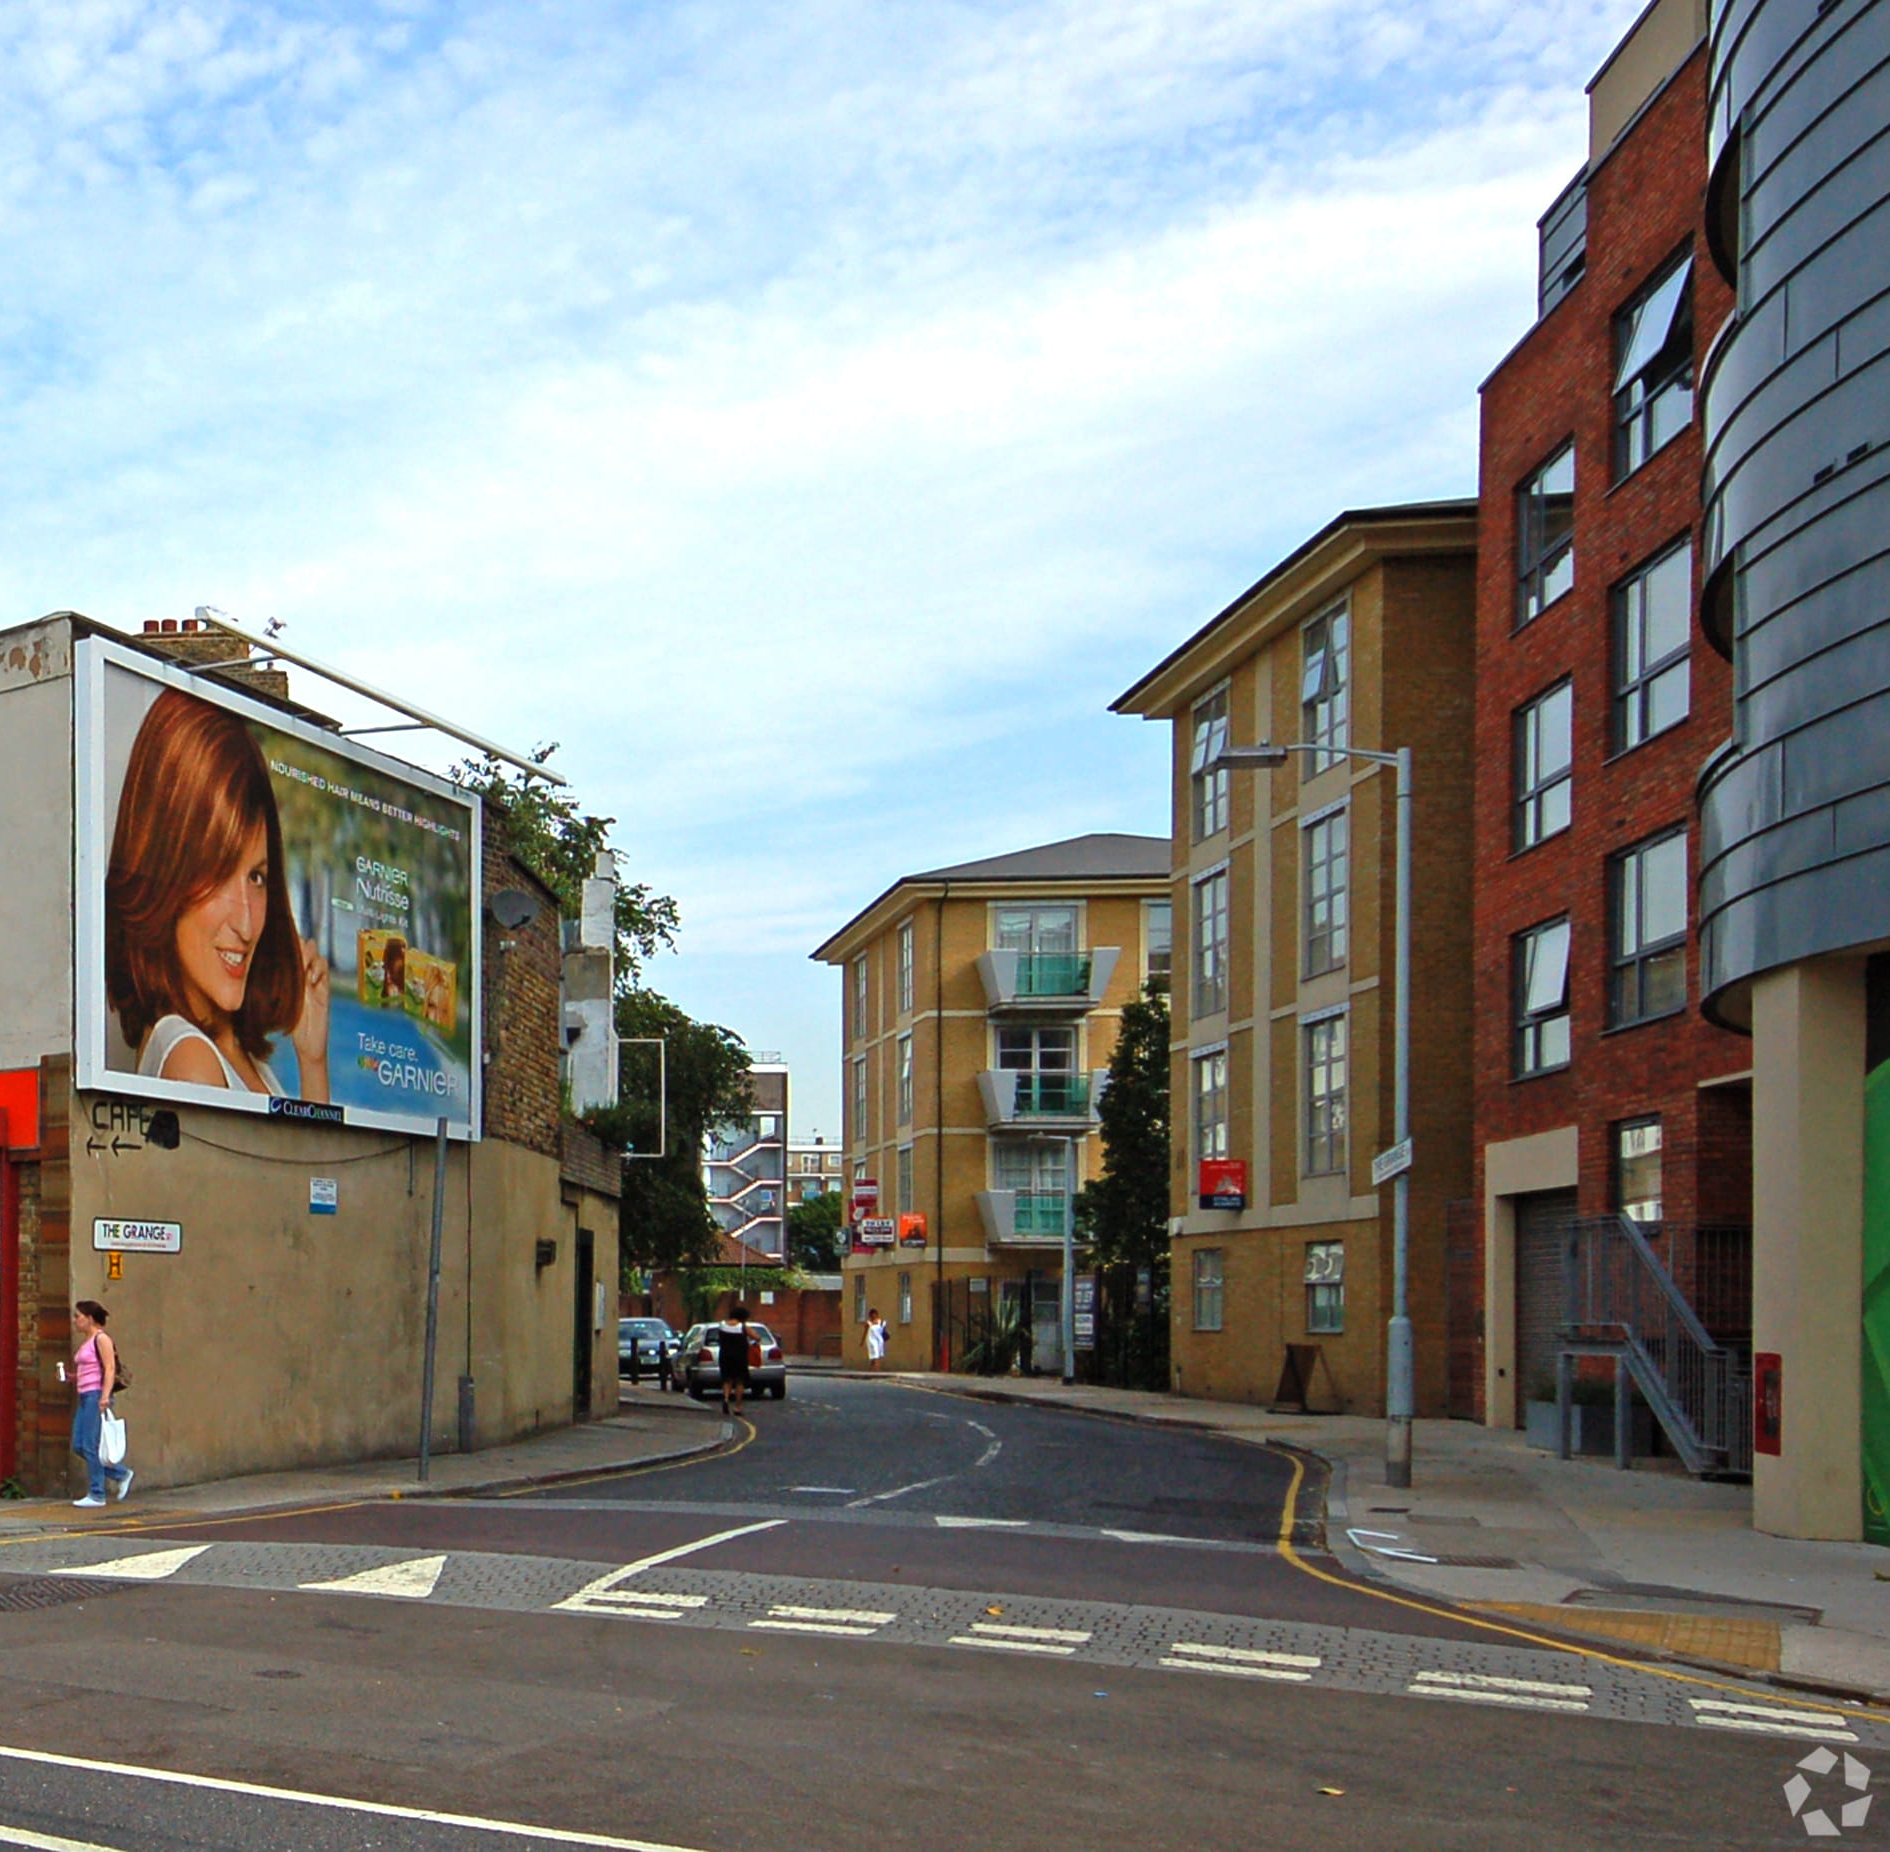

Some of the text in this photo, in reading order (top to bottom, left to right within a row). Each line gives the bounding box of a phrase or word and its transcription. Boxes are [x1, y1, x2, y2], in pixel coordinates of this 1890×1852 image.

[270, 760, 460, 841] NOURISHED HAIR MEANS BETTER HIGHLIGHTS
[356, 856, 408, 886] GARNIER
[357, 1032, 385, 1055] Take
[378, 1060, 459, 1097] GARNIER
[102, 1223, 120, 1238] THE
[123, 1224, 166, 1240] GRANGE
